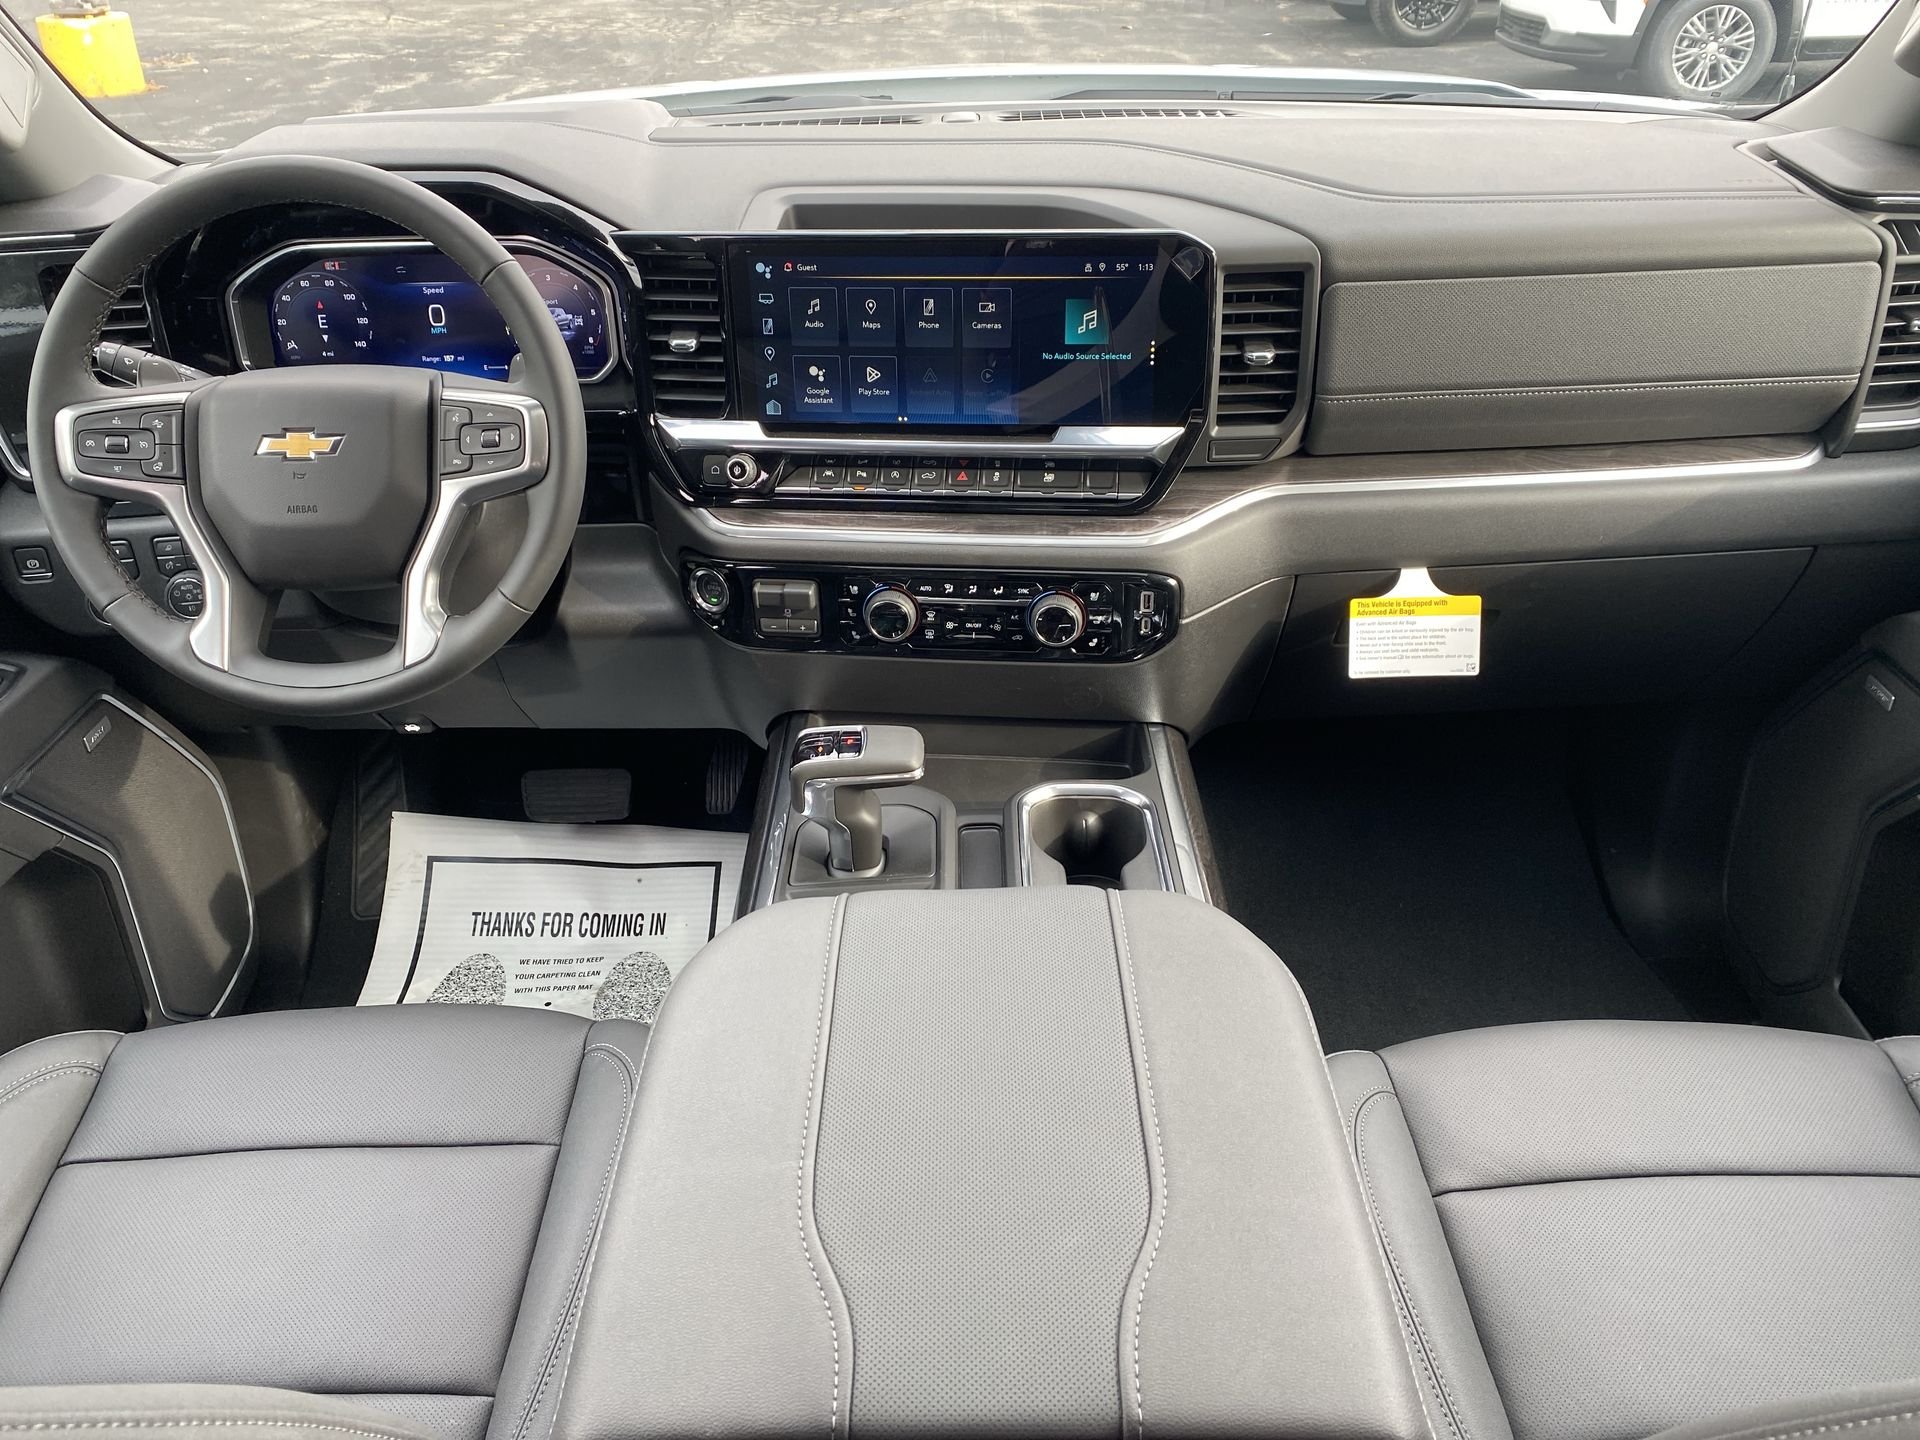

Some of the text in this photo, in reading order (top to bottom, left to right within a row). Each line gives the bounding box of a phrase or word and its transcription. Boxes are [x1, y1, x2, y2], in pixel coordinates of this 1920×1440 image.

[797, 262, 818, 273] Guest
[1116, 263, 1129, 271] 55°
[1138, 263, 1154, 271] 1:13
[422, 286, 444, 295] Speed
[428, 304, 445, 326] 0
[590, 308, 596, 316] 5
[277, 318, 287, 326] 20
[317, 314, 328, 329] E
[804, 320, 824, 329] Audio
[862, 320, 881, 330] Maps
[918, 320, 940, 330] Phone
[971, 321, 1002, 330] Cameras
[354, 340, 367, 348] 140
[588, 336, 594, 344] 6
[421, 355, 441, 364] Range:
[1042, 352, 1132, 360] No Audio Source Selected
[806, 387, 830, 397] Google
[858, 387, 890, 397] Play Store
[804, 396, 833, 404] Assistant
[286, 504, 319, 514] AIRBAG
[1017, 587, 1030, 595] SYNC
[1371, 600, 1394, 608] Vehicle
[1402, 600, 1432, 608] Equipped
[1399, 608, 1416, 616] Bags
[471, 912, 667, 938] THANKS FOR COMING IN
[533, 958, 552, 966] HAVE
[586, 956, 605, 964] KEEP
[515, 970, 601, 980] YOUR CARPETING CLEAN
[514, 986, 532, 994] WITH
[552, 985, 577, 993] PAPER
